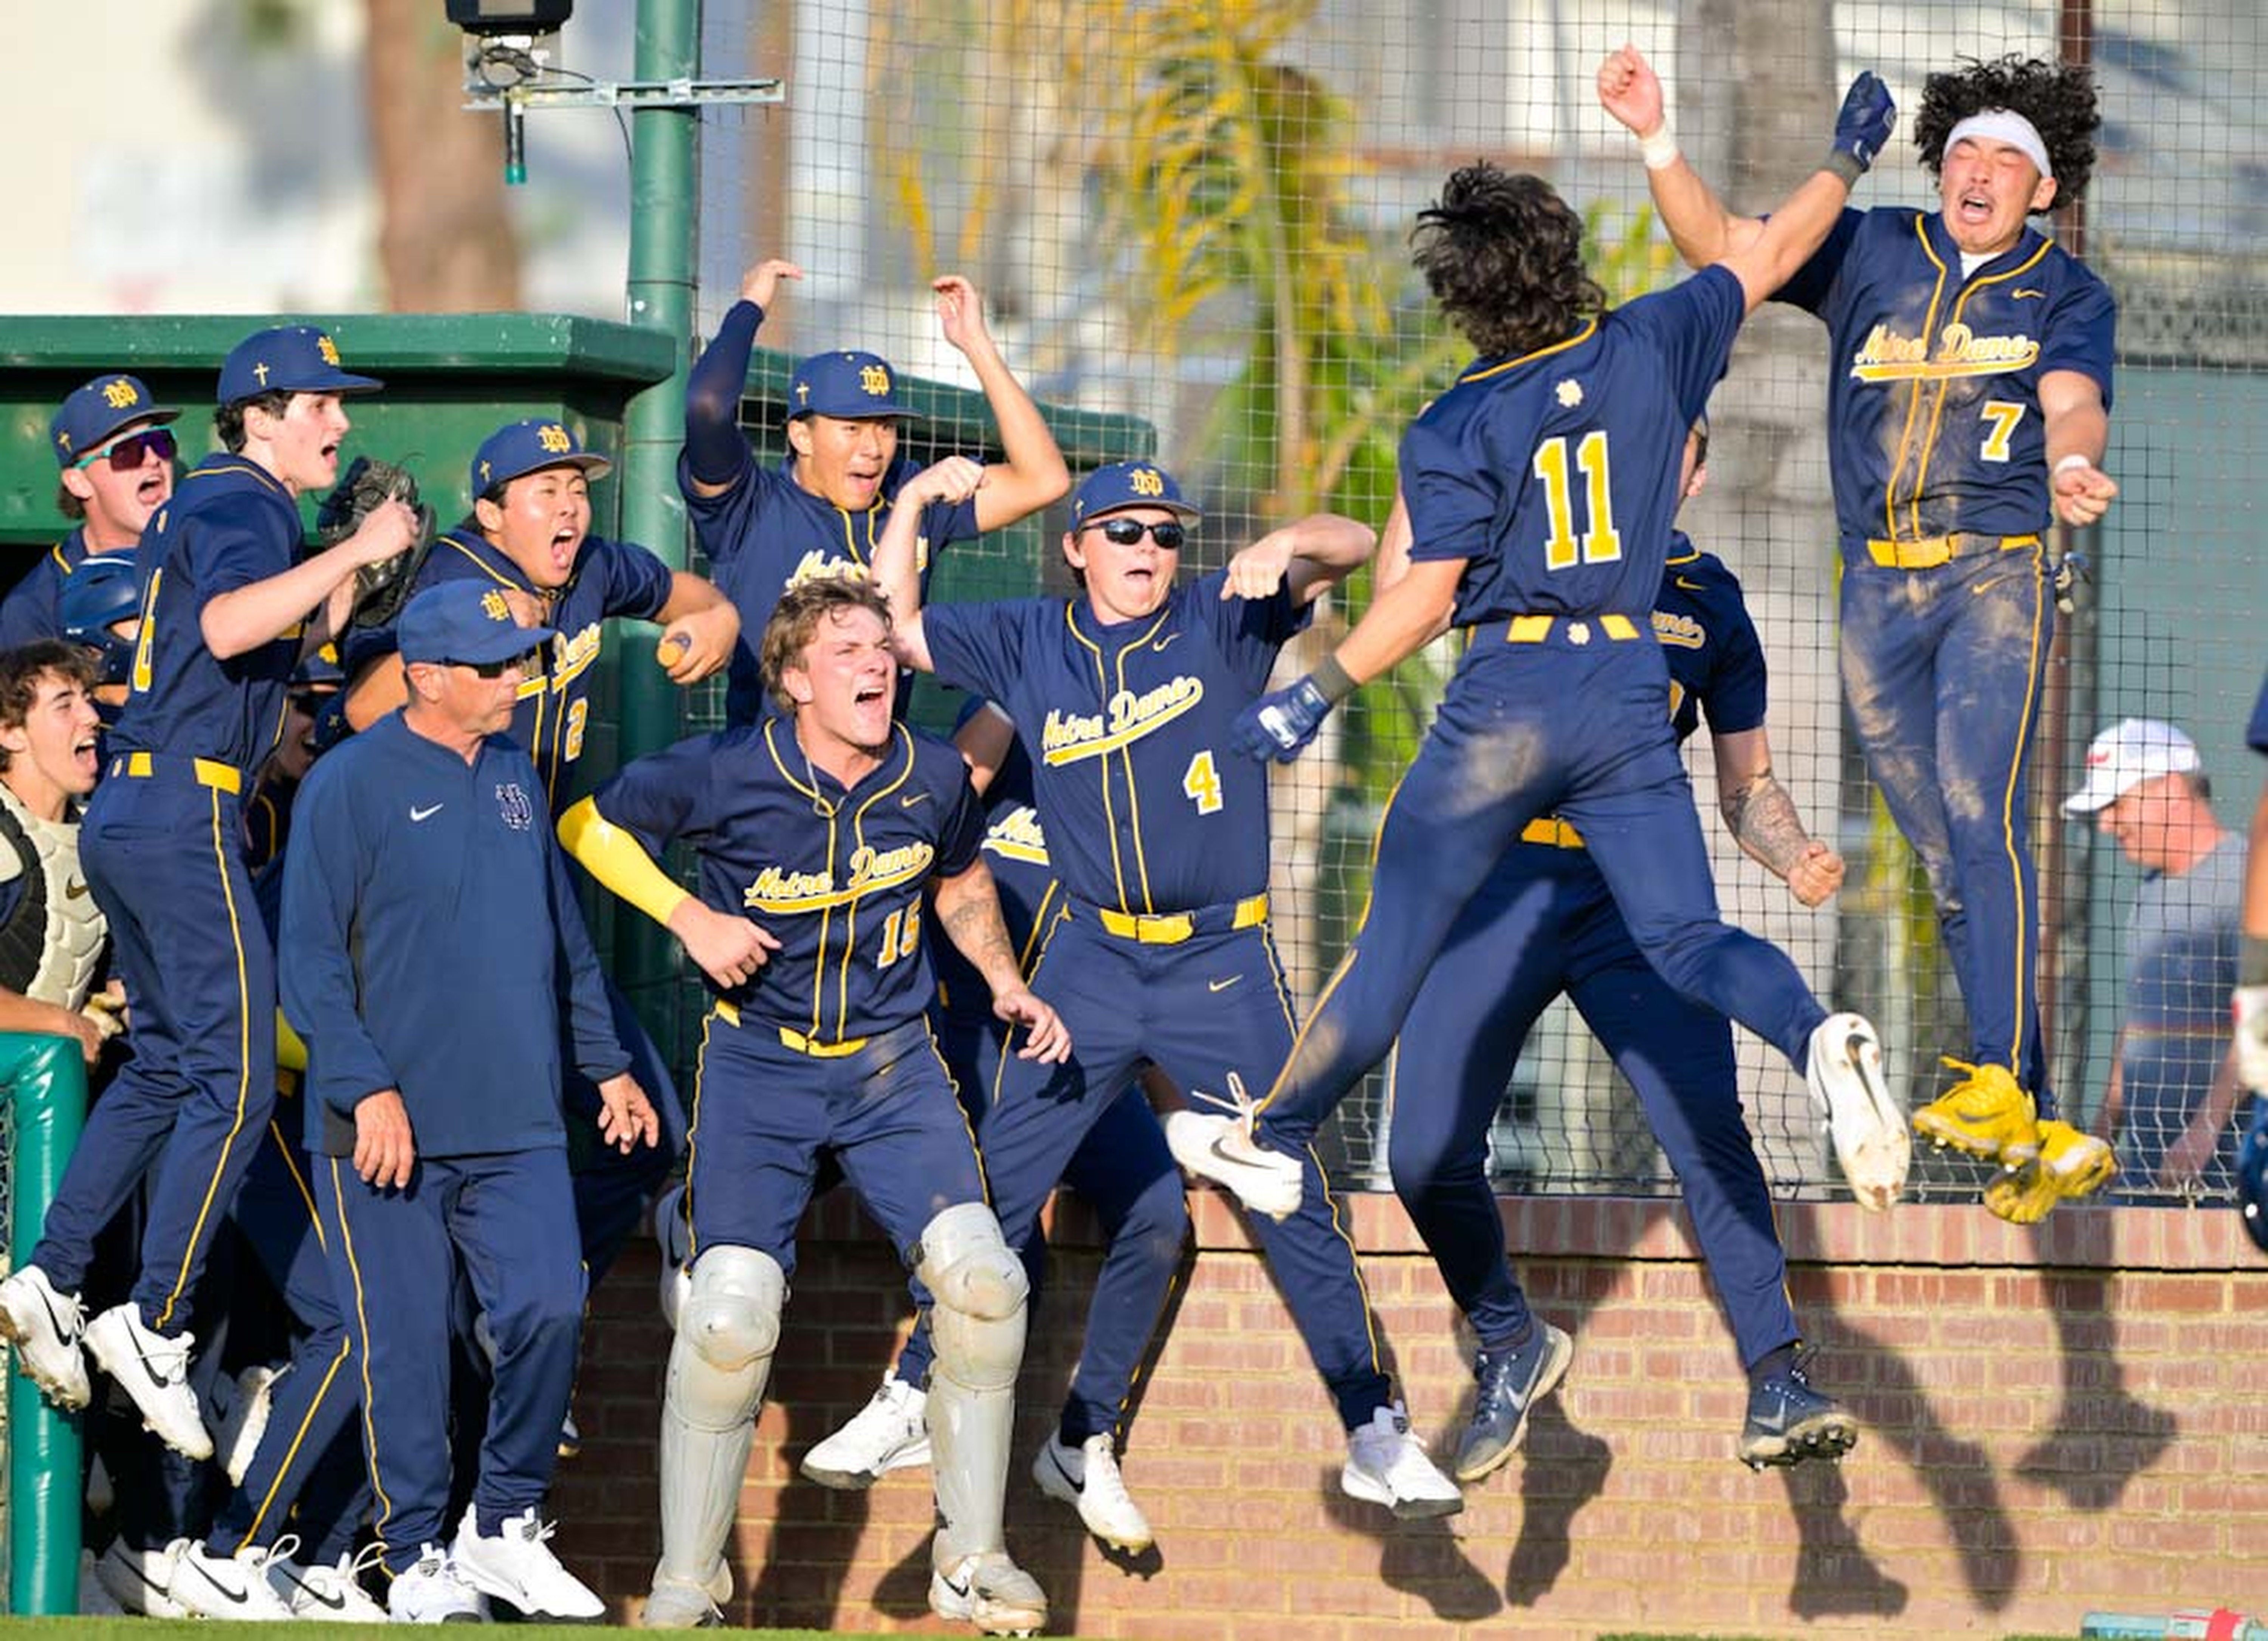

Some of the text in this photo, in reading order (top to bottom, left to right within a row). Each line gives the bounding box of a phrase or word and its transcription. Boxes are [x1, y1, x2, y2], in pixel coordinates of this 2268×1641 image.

[1936, 323, 2040, 362] Dame
[1980, 401, 2026, 461] 7
[1533, 430, 1622, 570] 11
[565, 697, 588, 762] 2
[1043, 709, 1104, 751] Notre
[1108, 676, 1204, 733] Dame
[1183, 750, 1223, 815] 4
[744, 841, 934, 899] Notre Dame
[877, 891, 922, 969] 15
